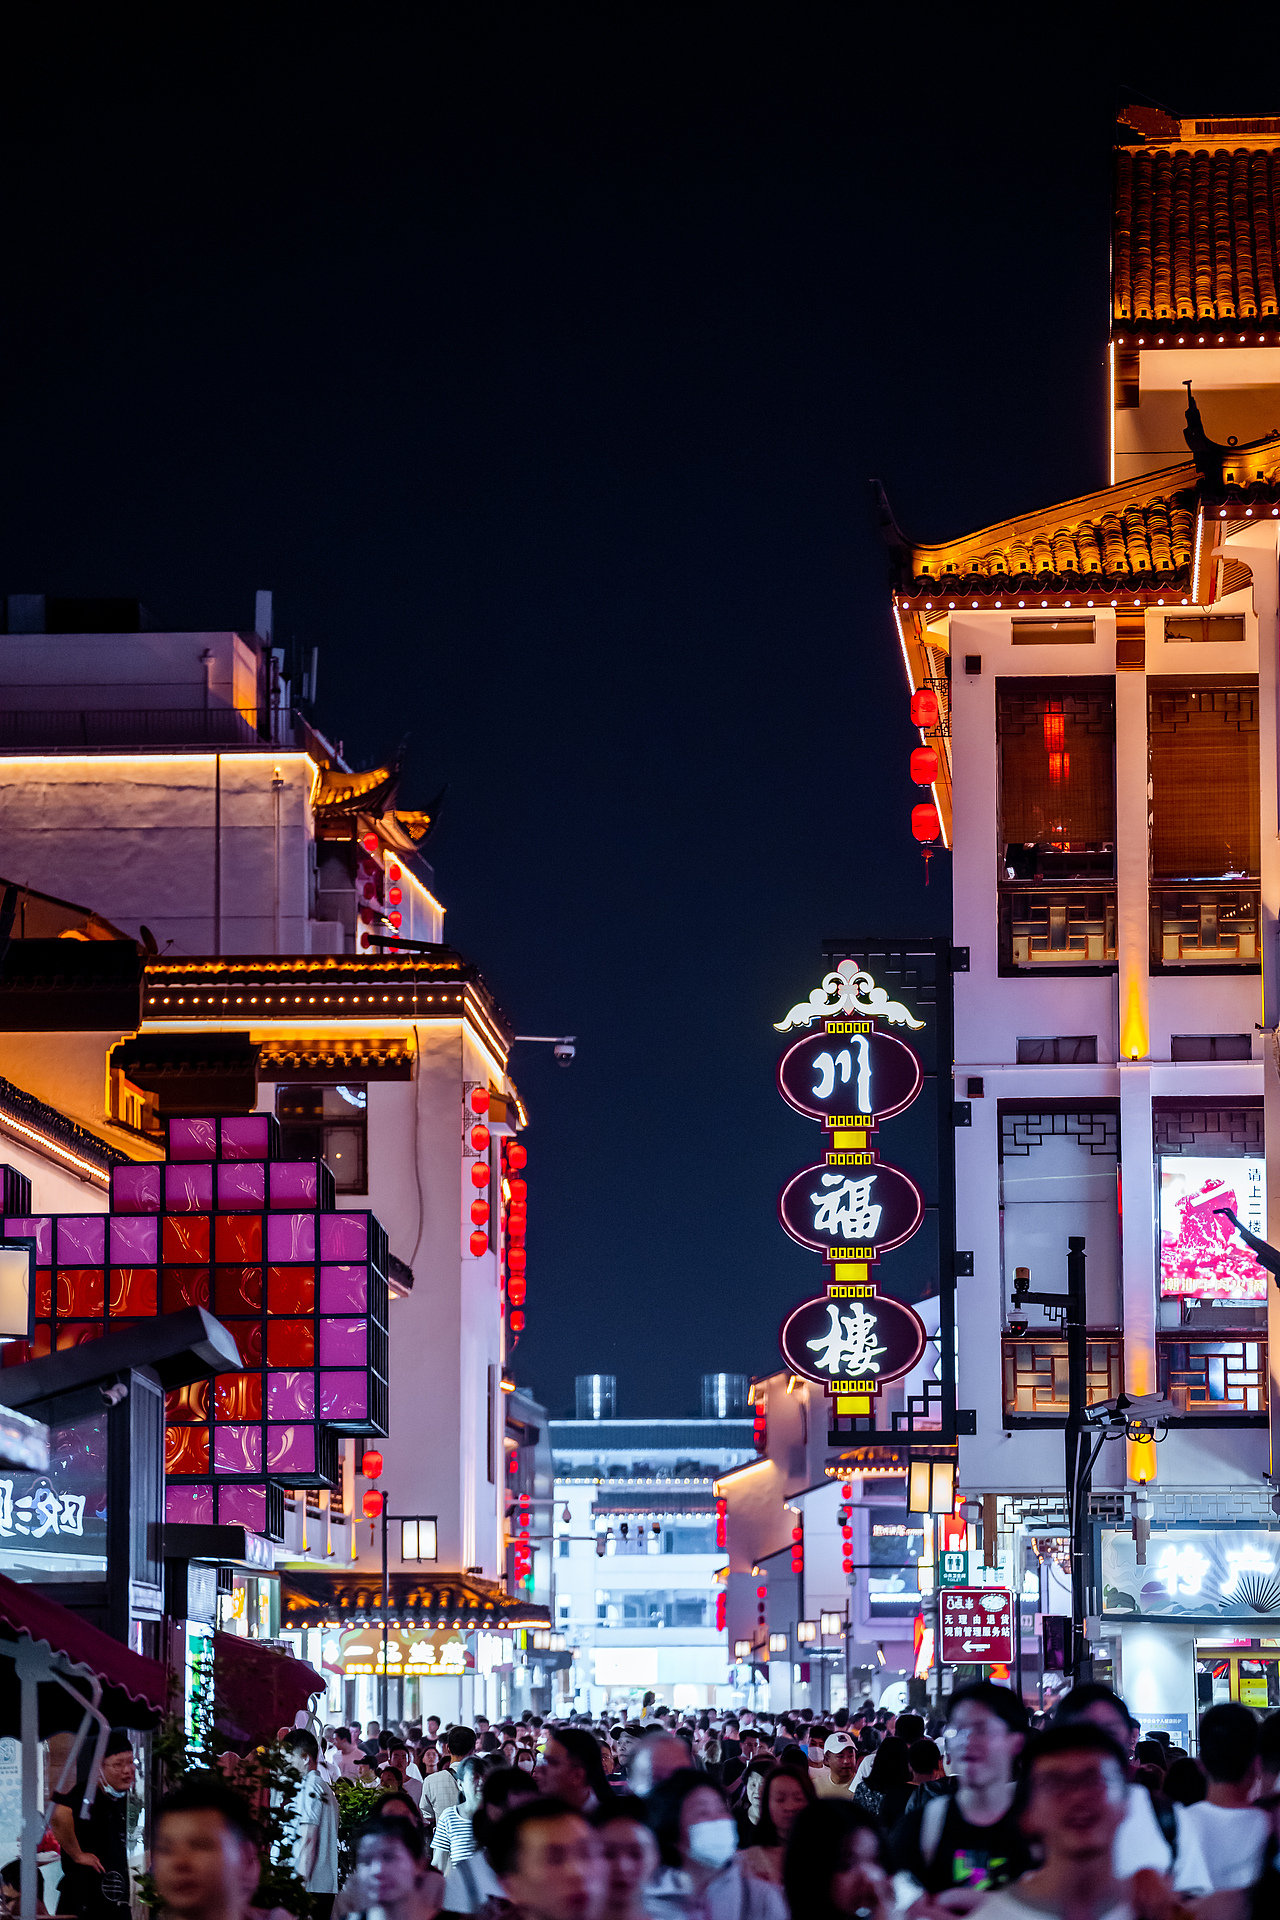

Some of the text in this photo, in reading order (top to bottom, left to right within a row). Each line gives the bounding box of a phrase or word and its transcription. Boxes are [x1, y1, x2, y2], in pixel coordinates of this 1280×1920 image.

[1248, 1168, 1262, 1233] 请上二楼
[1164, 1278, 1264, 1293] 潮汕牛肉火锅
[1157, 1545, 1275, 1595] 特产
[944, 1614, 1010, 1625] 无理由退货
[944, 1626, 1010, 1637] 观前管理服务站
